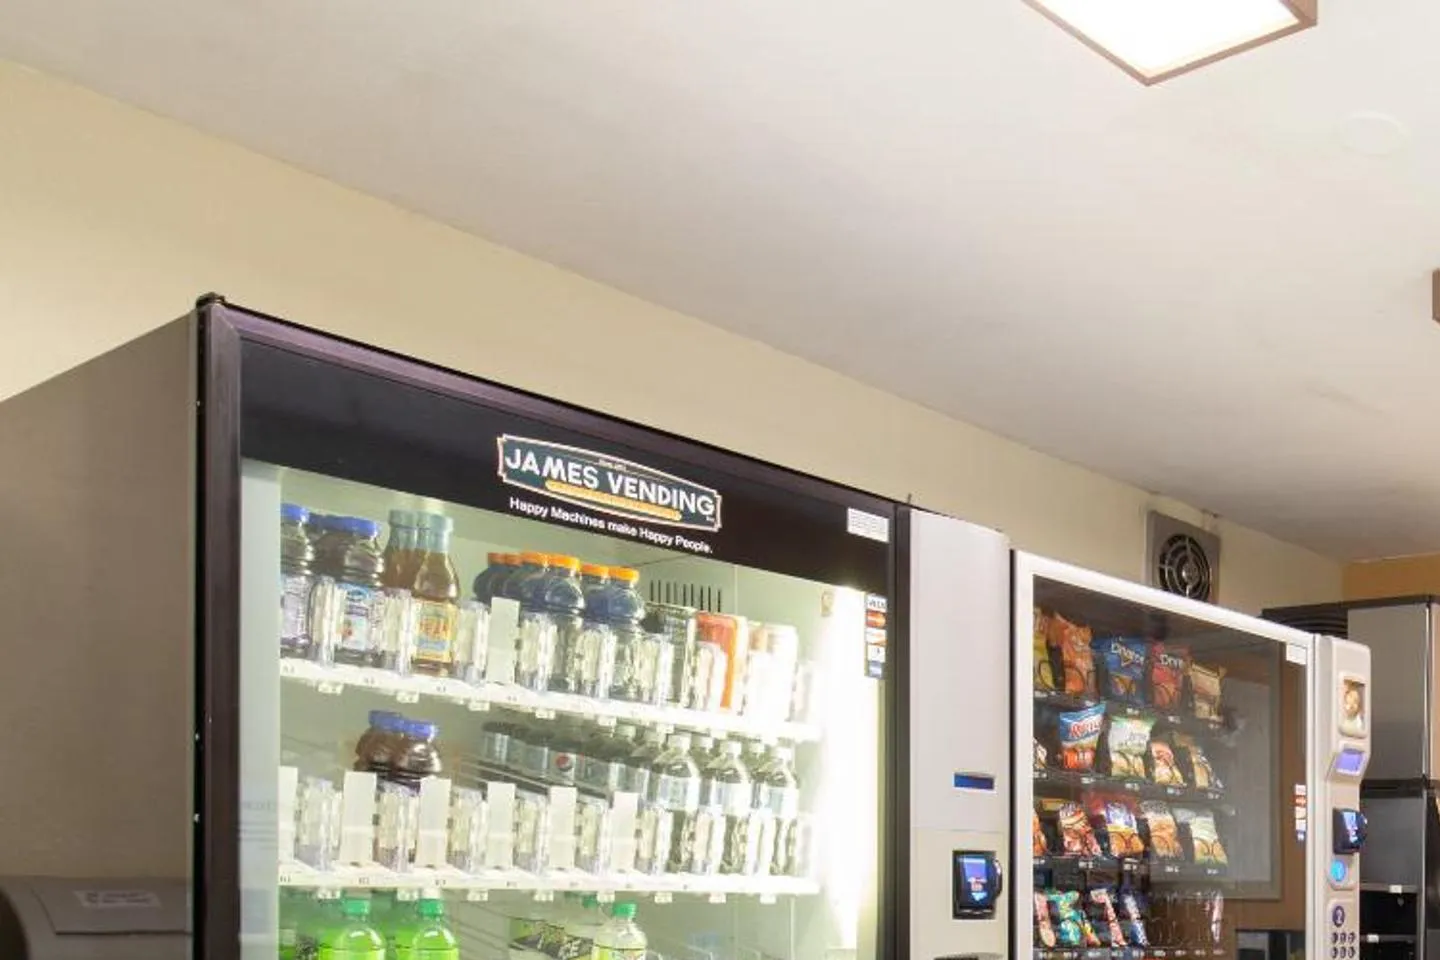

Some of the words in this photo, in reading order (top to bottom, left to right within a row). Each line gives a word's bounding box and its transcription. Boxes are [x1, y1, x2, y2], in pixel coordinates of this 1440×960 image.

[505, 448, 600, 490] JAMES
[606, 471, 716, 516] VENDING
[509, 496, 549, 519] Happy
[550, 505, 605, 530] Machines
[608, 521, 638, 537] make
[639, 526, 674, 547] Happy
